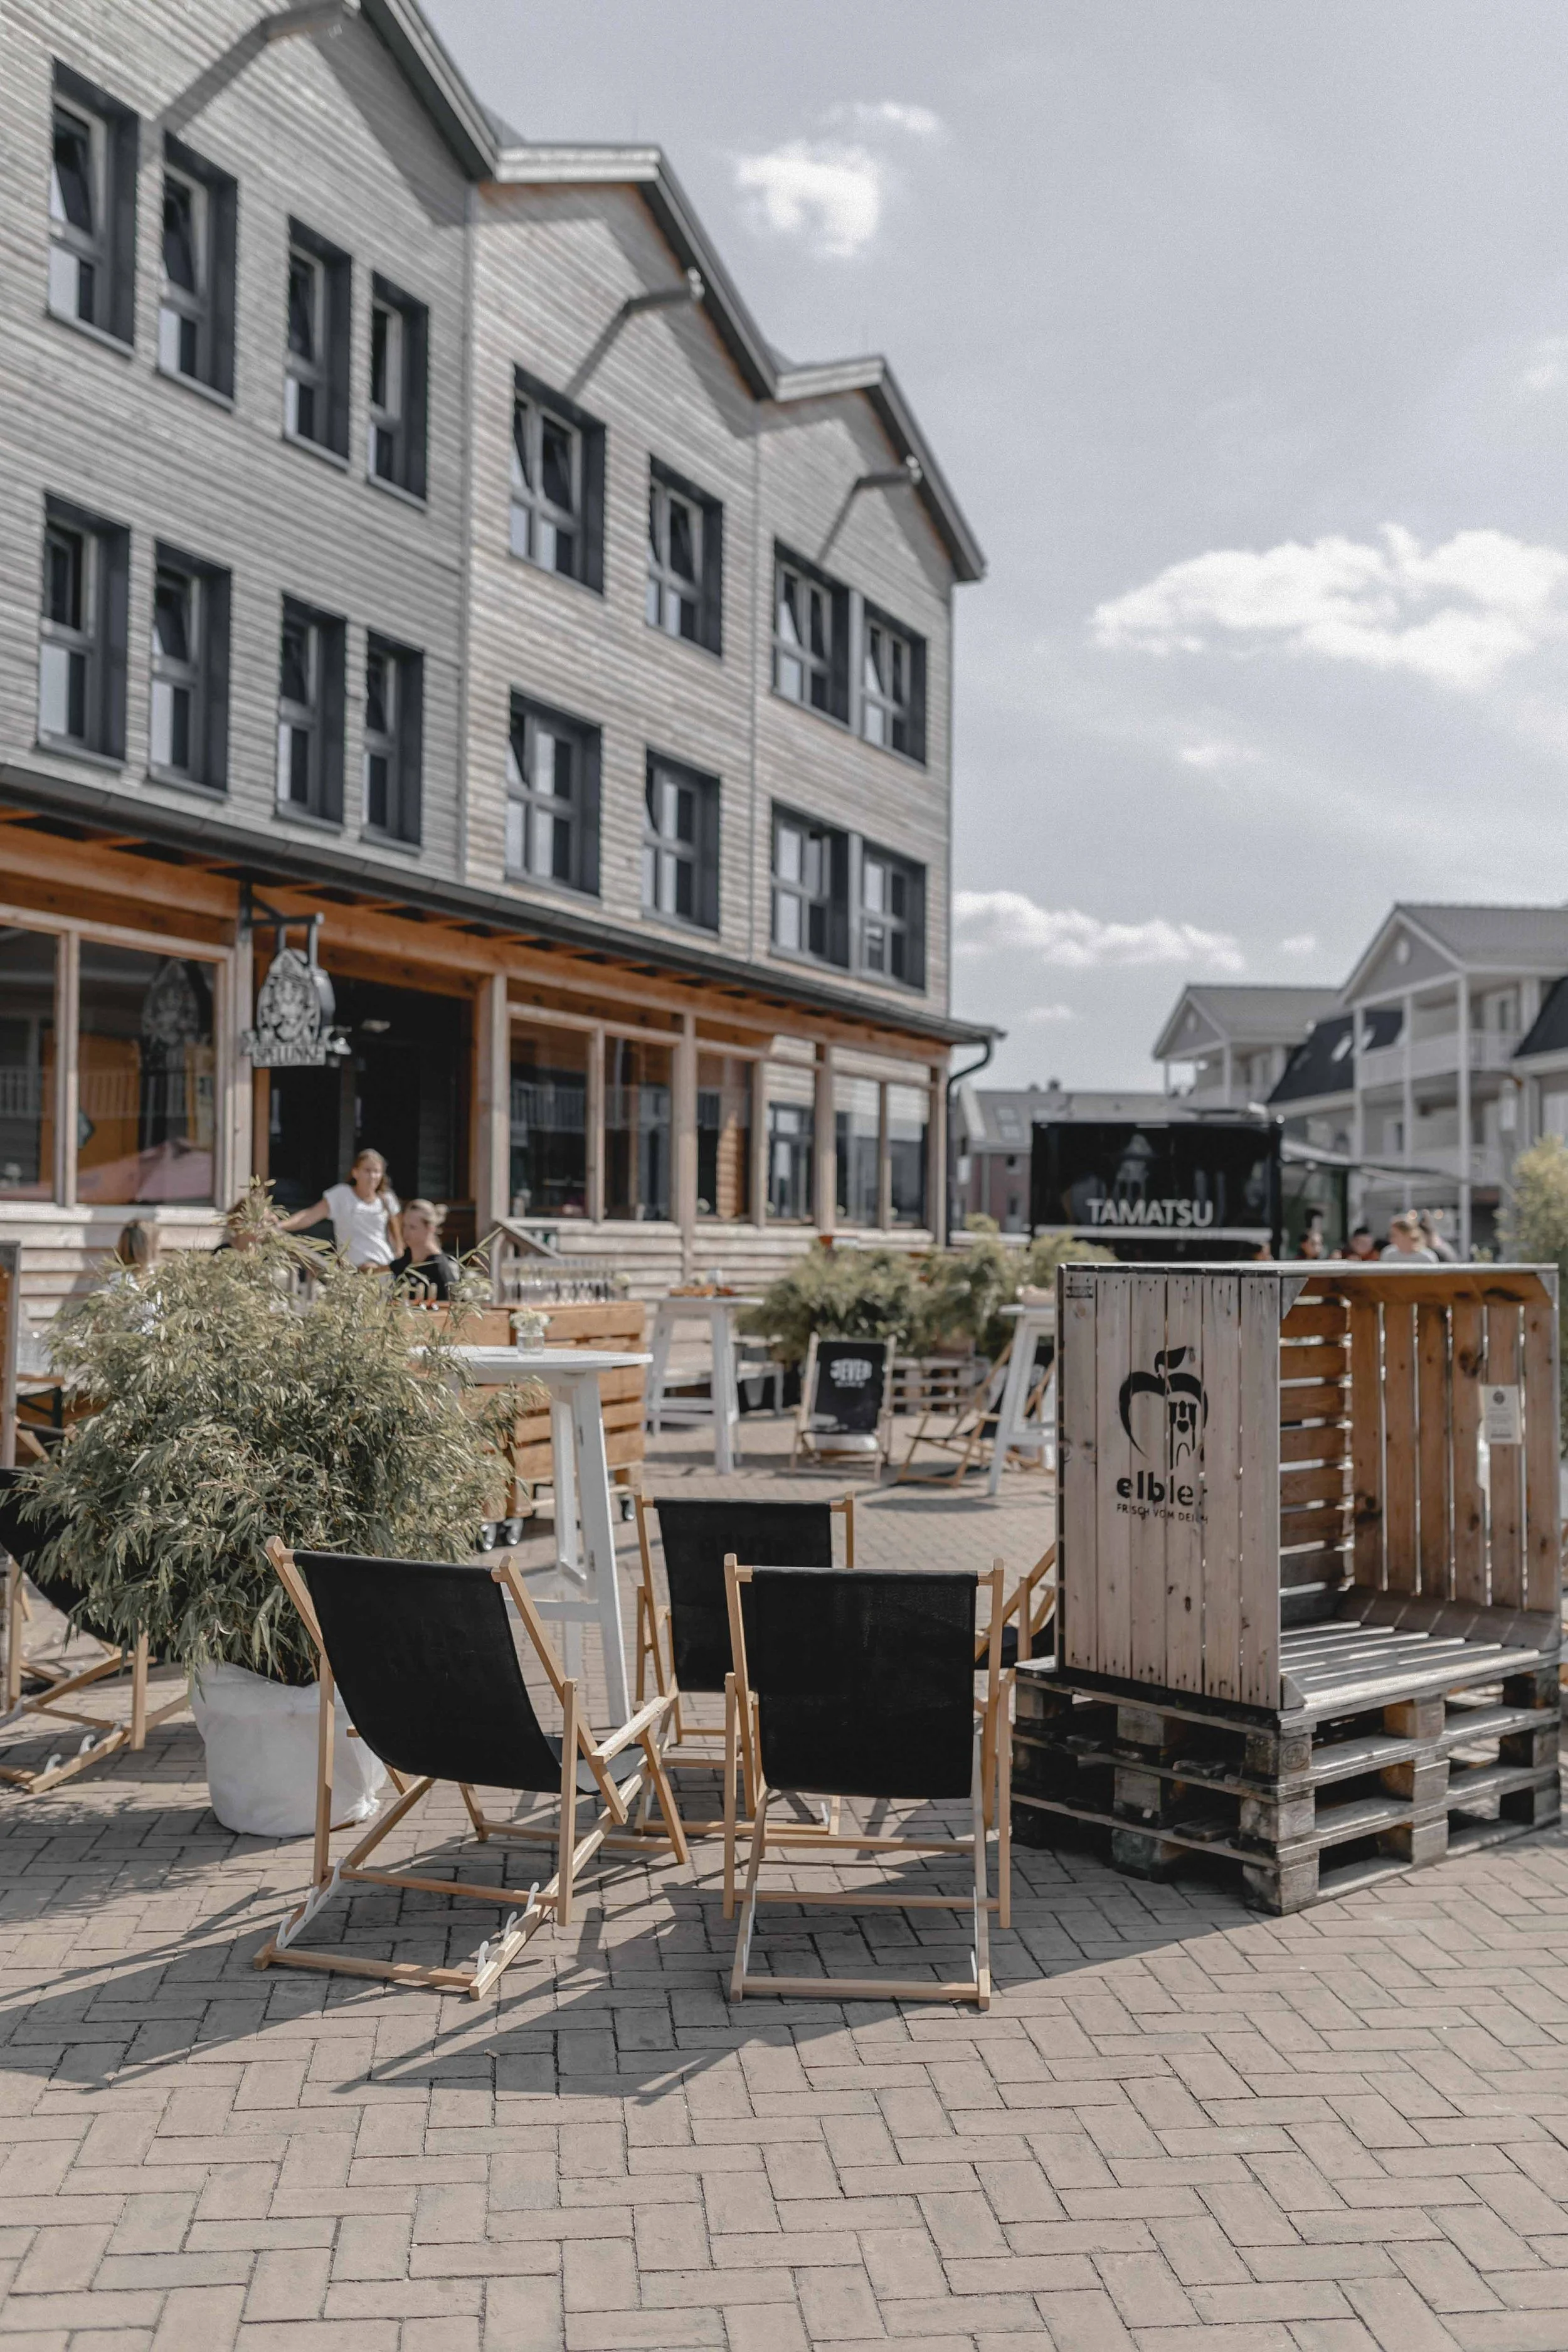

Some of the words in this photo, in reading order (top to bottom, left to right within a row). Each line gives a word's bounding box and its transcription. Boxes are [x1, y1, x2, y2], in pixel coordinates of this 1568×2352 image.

[1086, 1199, 1213, 1227] TAMATSU
[1116, 1503, 1150, 1516] FRSCH
[1153, 1509, 1175, 1520] VOM
[1179, 1512, 1208, 1524] DEIH
